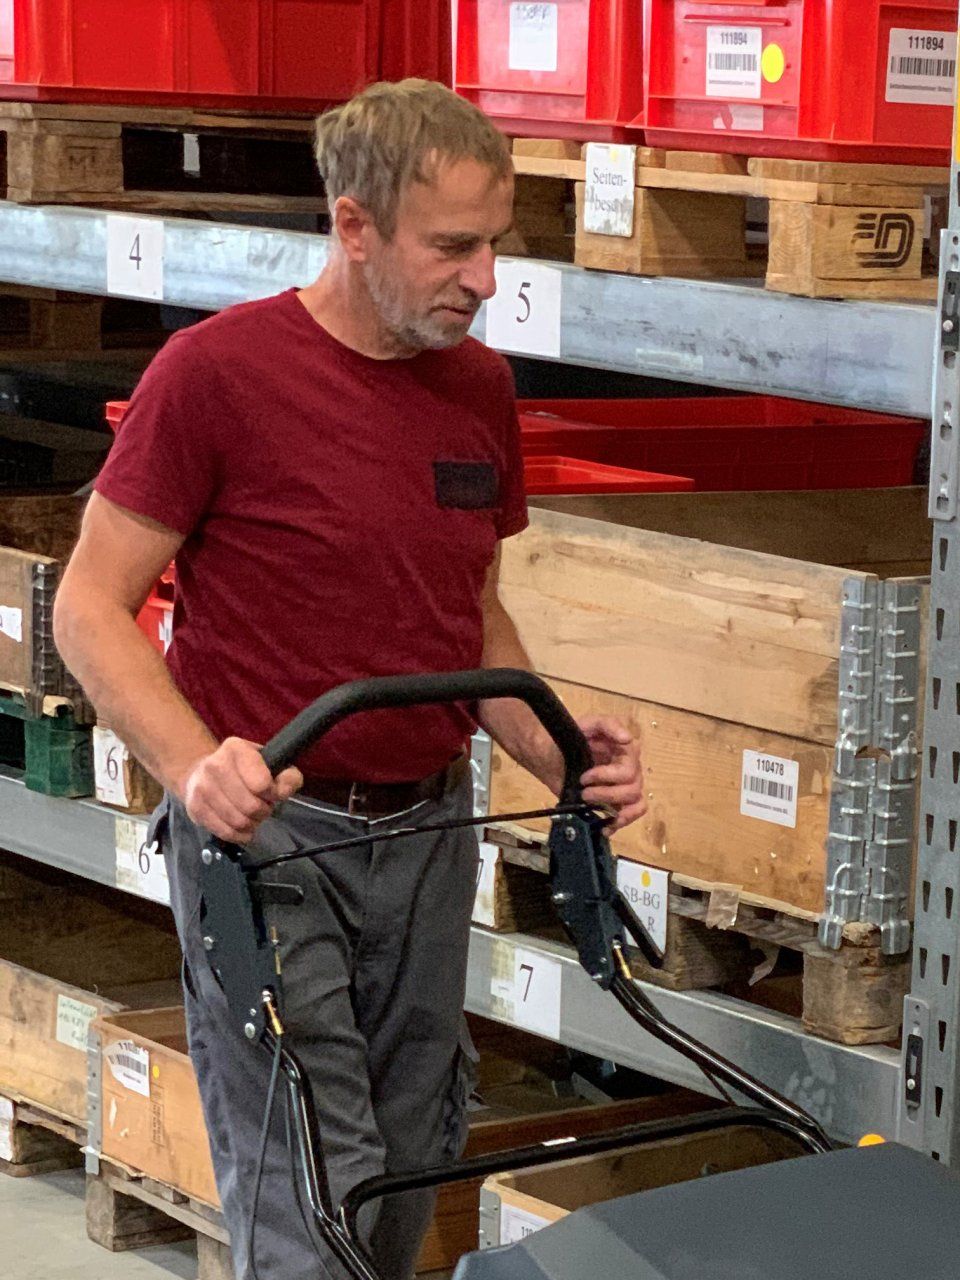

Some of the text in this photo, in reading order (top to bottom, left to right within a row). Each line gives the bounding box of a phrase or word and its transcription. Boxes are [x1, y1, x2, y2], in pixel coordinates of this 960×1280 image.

[720, 31, 748, 46] 111894
[908, 35, 945, 51] 111894
[592, 166, 628, 187] Seiten-
[128, 232, 143, 271] 4
[516, 281, 531, 324] 5
[106, 746, 119, 781] 6
[756, 758, 785, 777] 110478
[138, 842, 151, 875] 6
[623, 885, 661, 910] SB-BG
[647, 915, 656, 933] R
[519, 963, 534, 1002] 7
